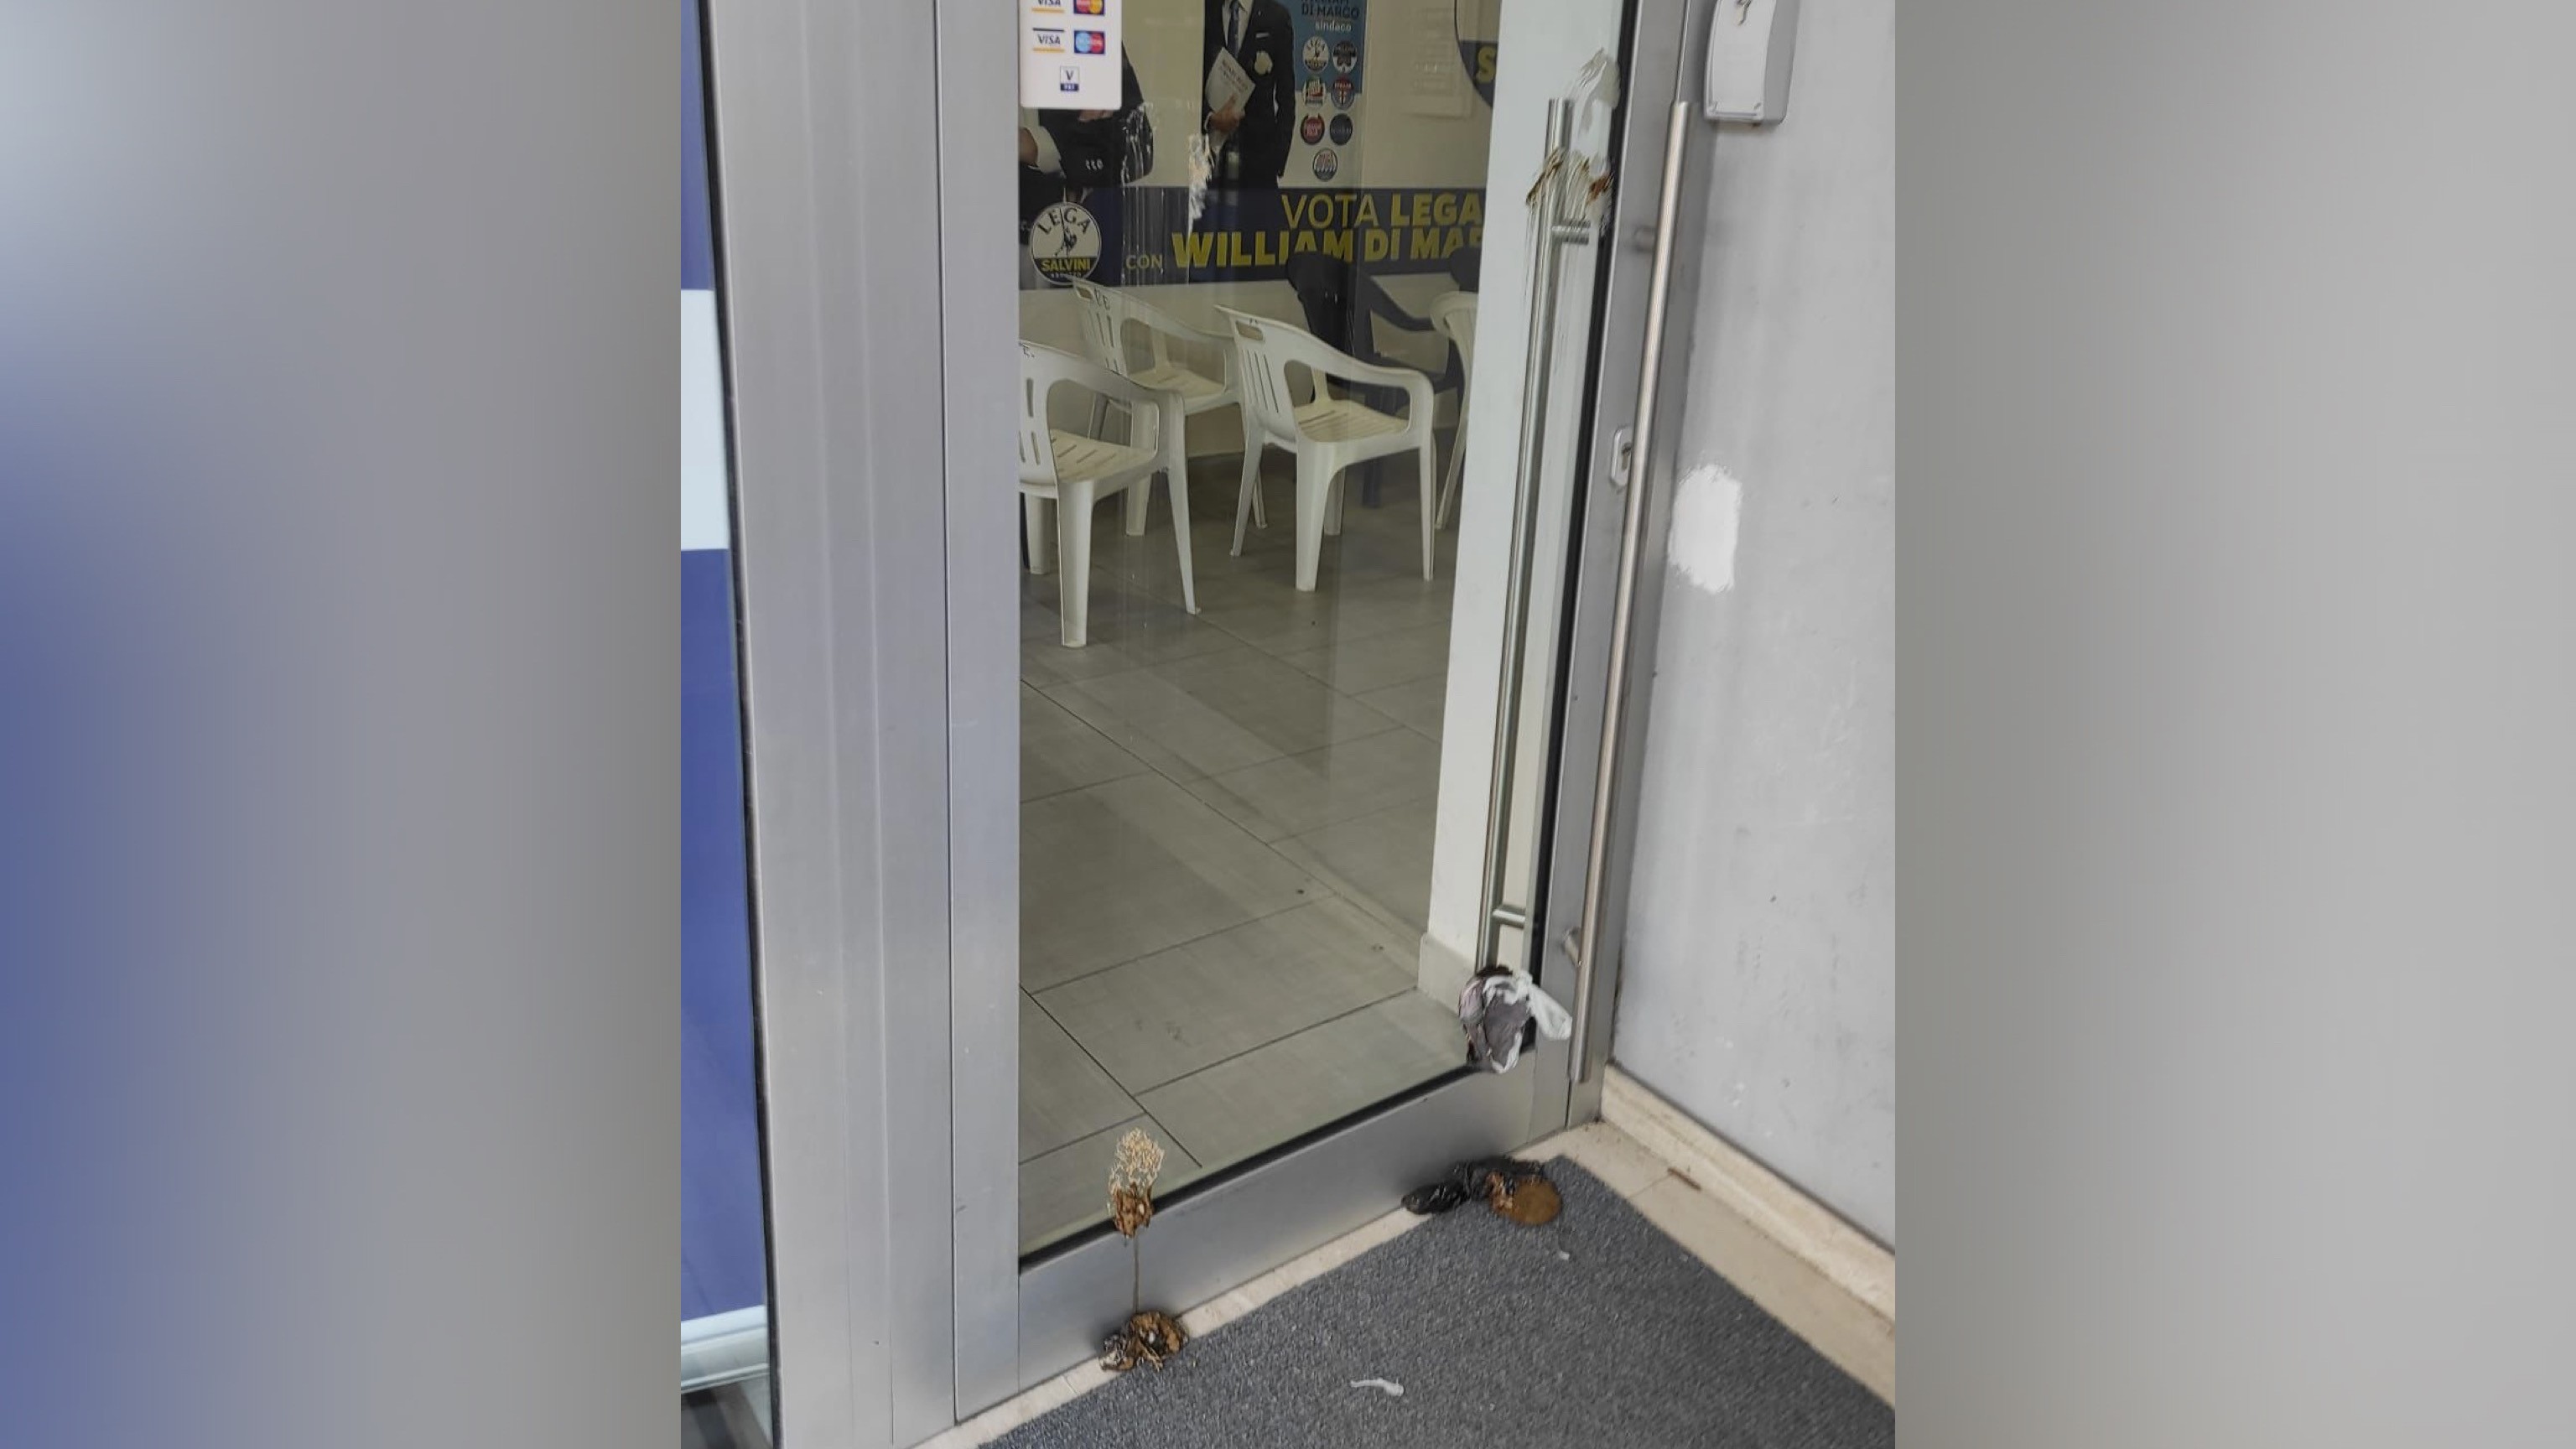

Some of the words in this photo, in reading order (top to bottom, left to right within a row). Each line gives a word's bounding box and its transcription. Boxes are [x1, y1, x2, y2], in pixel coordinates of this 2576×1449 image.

[1315, 20, 1352, 32] sindaco
[1037, 34, 1061, 44] VISA
[1036, 207, 1091, 235] LEGA
[1280, 193, 1379, 229] VOTA
[1390, 192, 1483, 226] LEGA
[1126, 254, 1163, 269] CON
[1171, 228, 1353, 268] WILLIAM
[1364, 226, 1401, 262] DI
[1041, 258, 1091, 272] SALVINI
